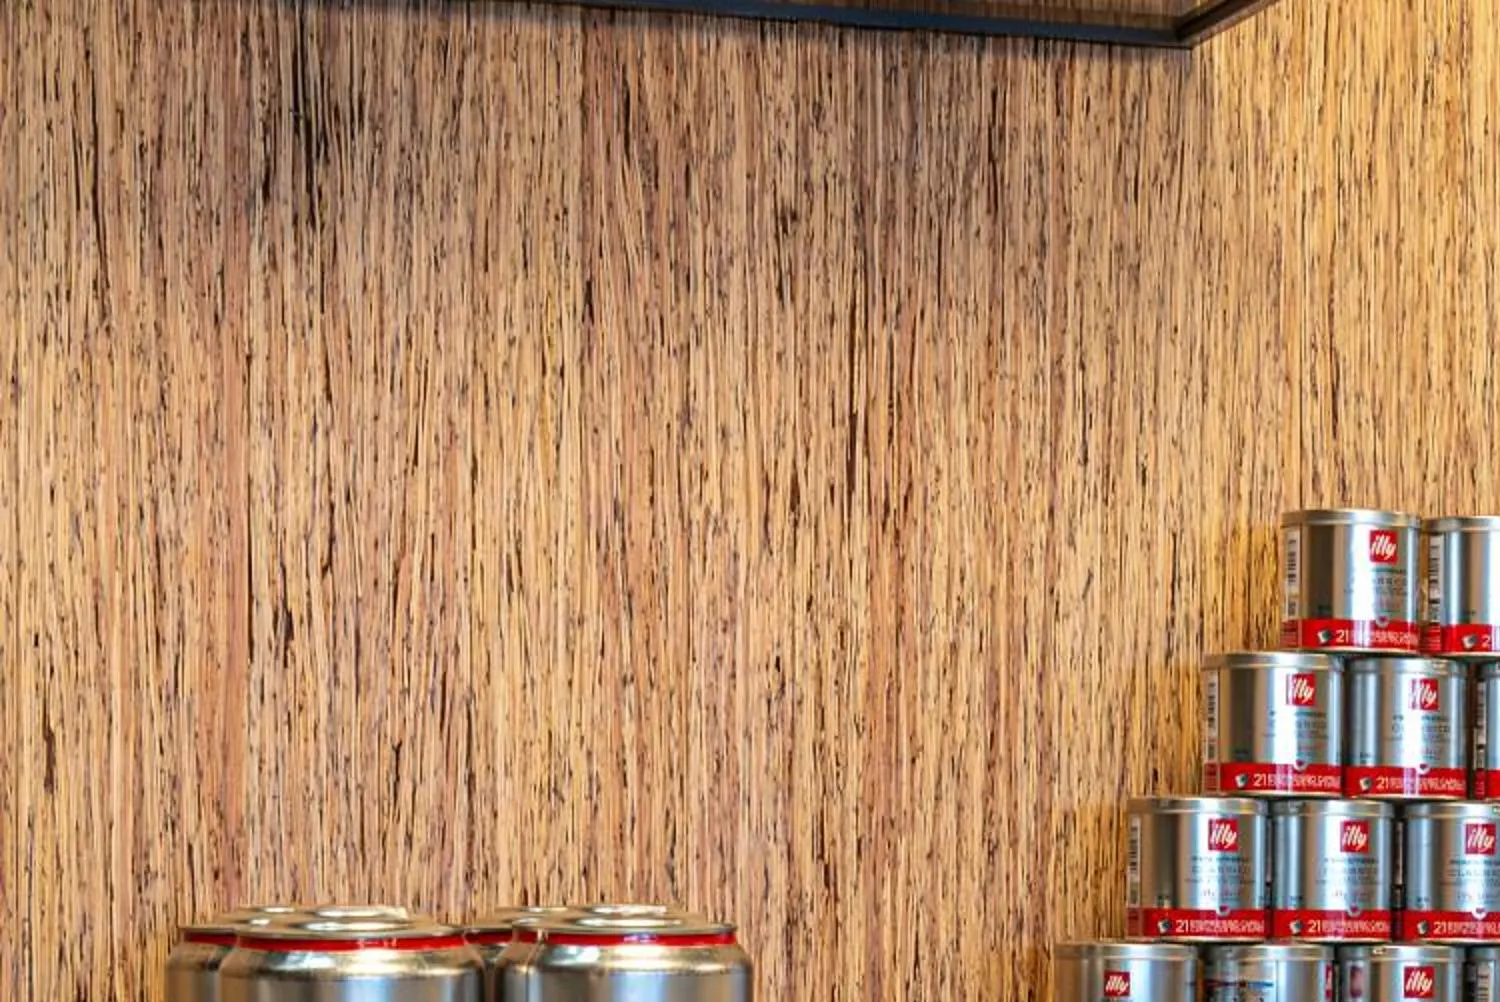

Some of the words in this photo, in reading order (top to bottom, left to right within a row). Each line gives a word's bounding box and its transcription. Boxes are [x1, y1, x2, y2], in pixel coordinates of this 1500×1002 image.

[1371, 535, 1396, 561] illy
[1288, 678, 1314, 703] illy
[1411, 683, 1437, 708] illy
[1210, 823, 1236, 849] illy
[1341, 825, 1367, 850] illy
[1467, 827, 1494, 852] illy
[1106, 975, 1128, 994] illy
[1406, 971, 1433, 995] illy
